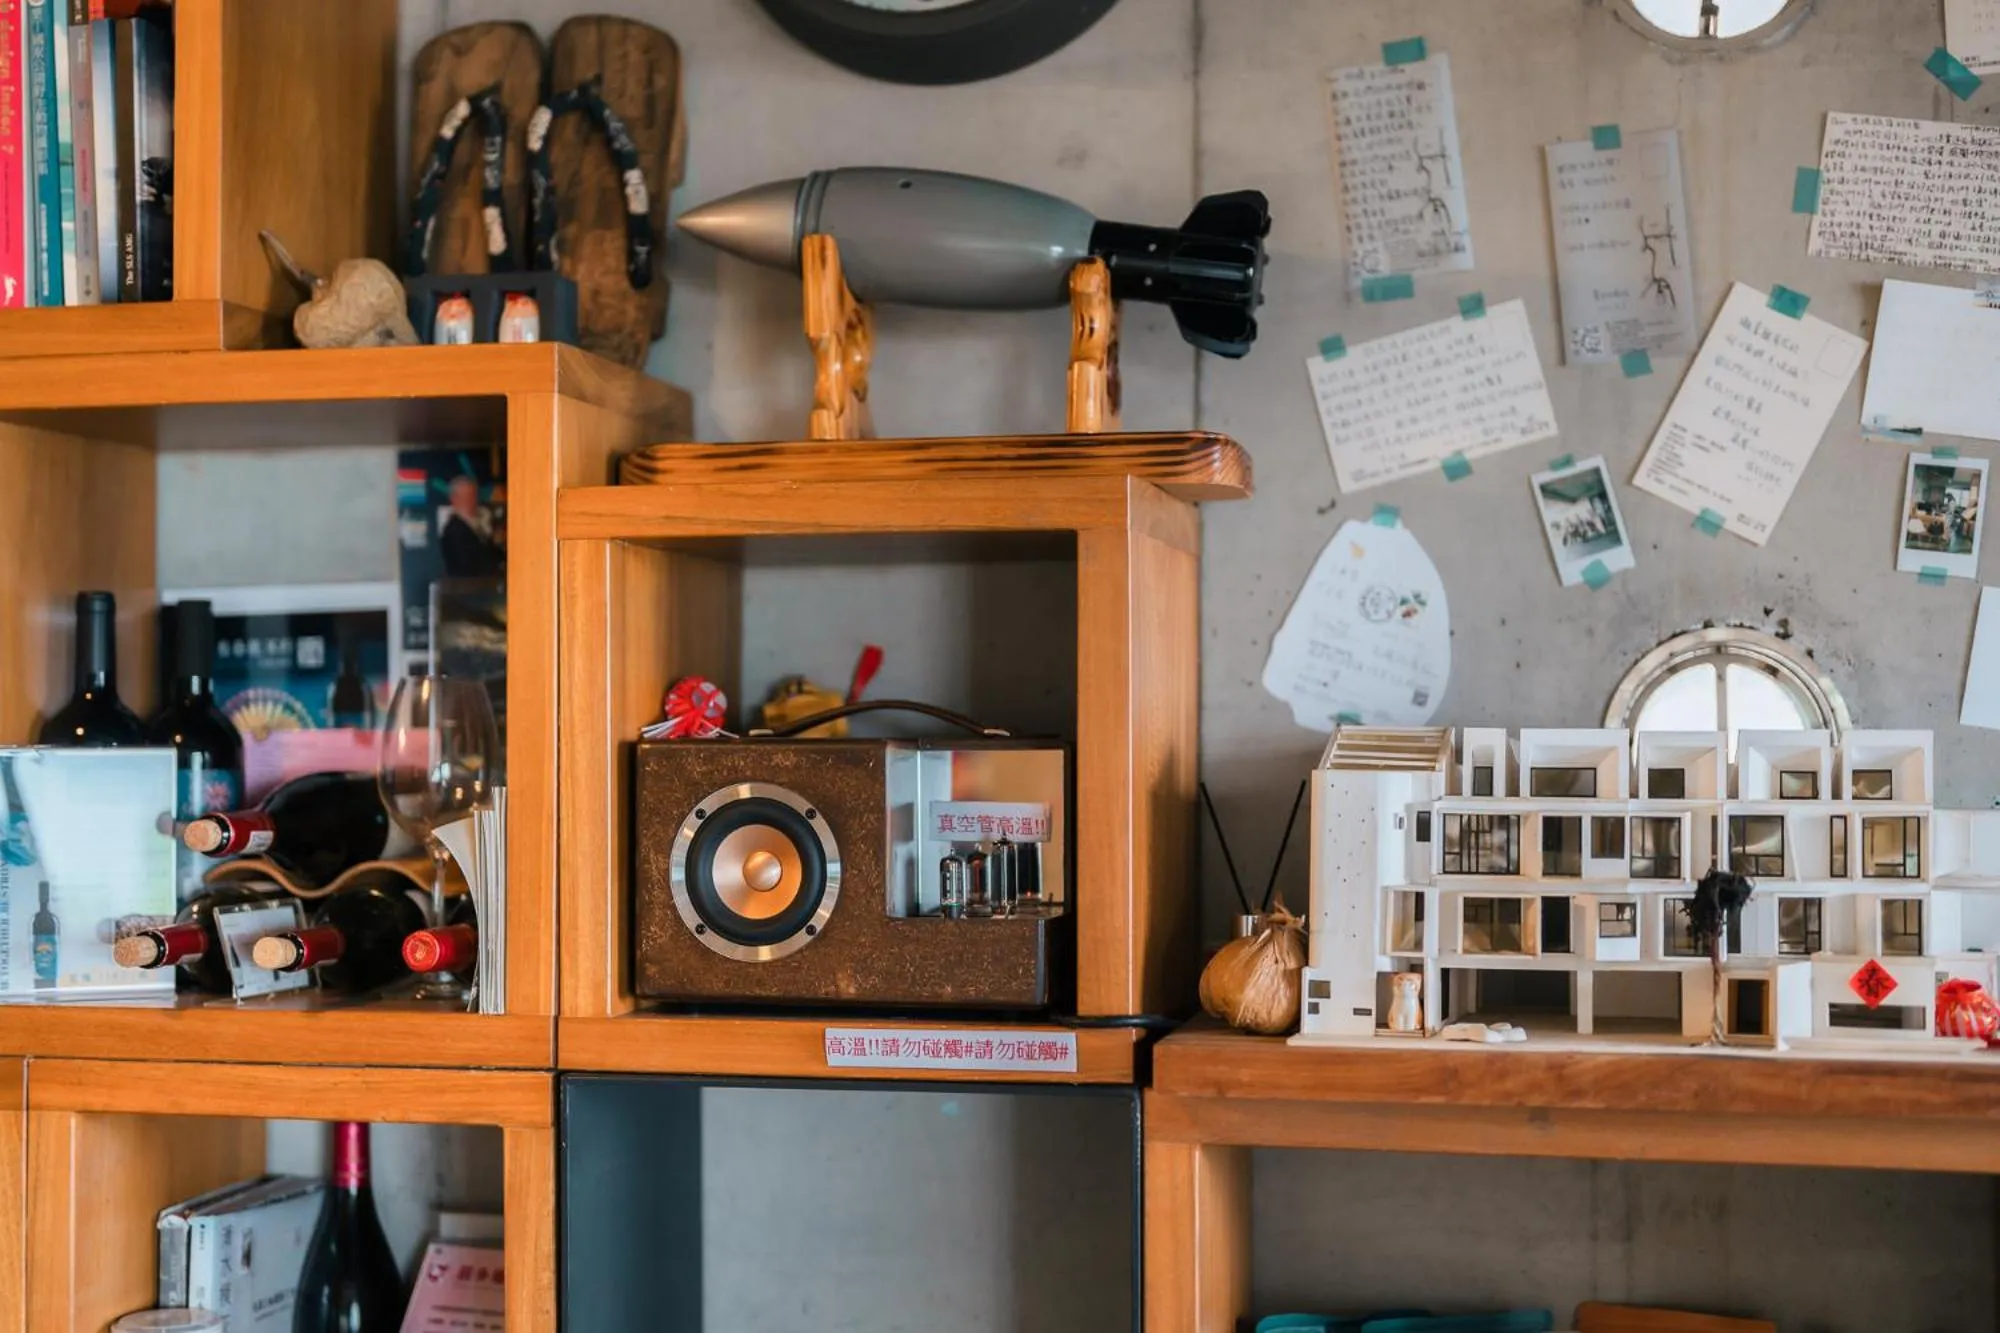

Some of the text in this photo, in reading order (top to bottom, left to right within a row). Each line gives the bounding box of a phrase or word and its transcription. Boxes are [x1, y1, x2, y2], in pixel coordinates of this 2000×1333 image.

[938, 813, 1047, 836] 真空管高溫!!
